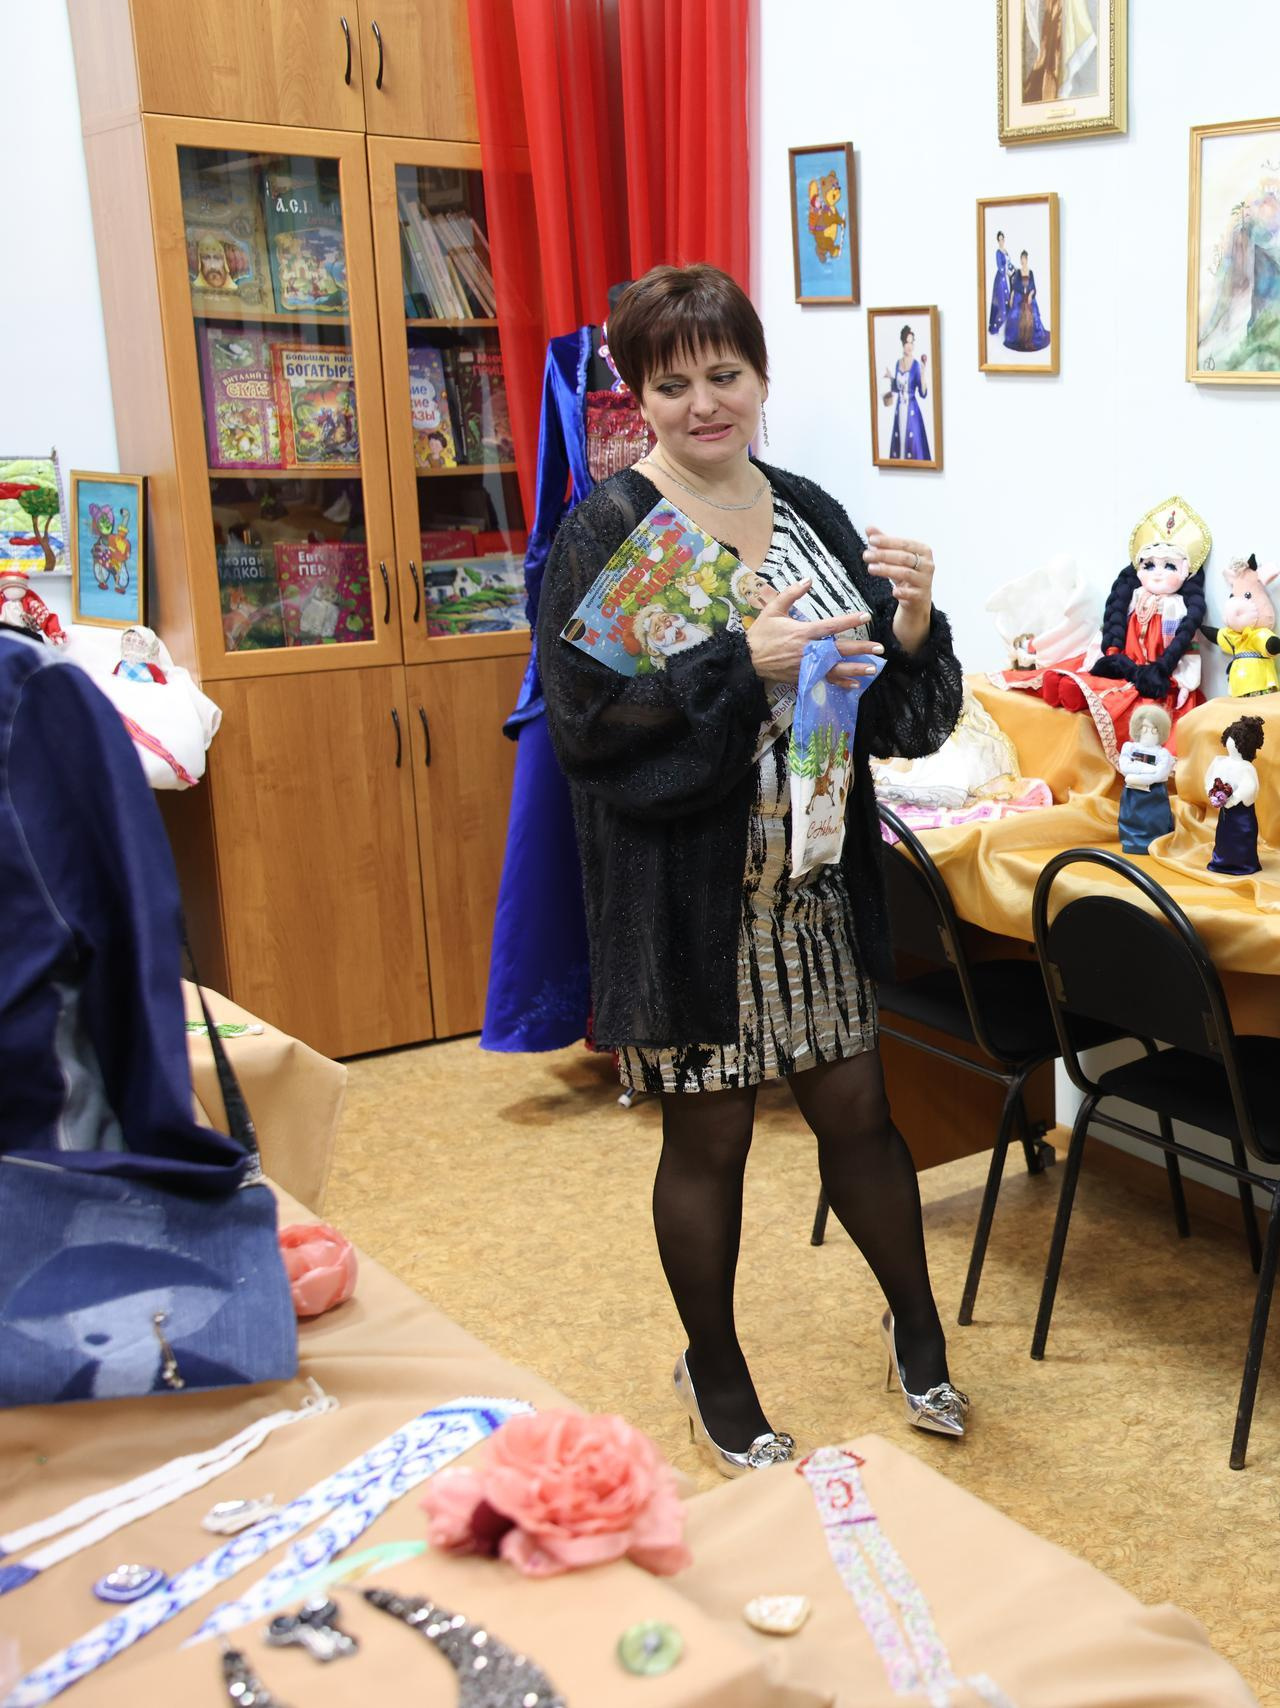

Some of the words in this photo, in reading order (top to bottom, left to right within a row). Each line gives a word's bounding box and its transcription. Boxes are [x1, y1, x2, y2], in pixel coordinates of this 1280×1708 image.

[286, 354, 330, 362] БОЛЬШАЯ
[583, 628, 601, 646] И
[601, 556, 656, 618] СНОВА
[656, 521, 687, 552] МЫ
[606, 615, 635, 643] НА
[636, 545, 689, 606] СЦЕНЕ
